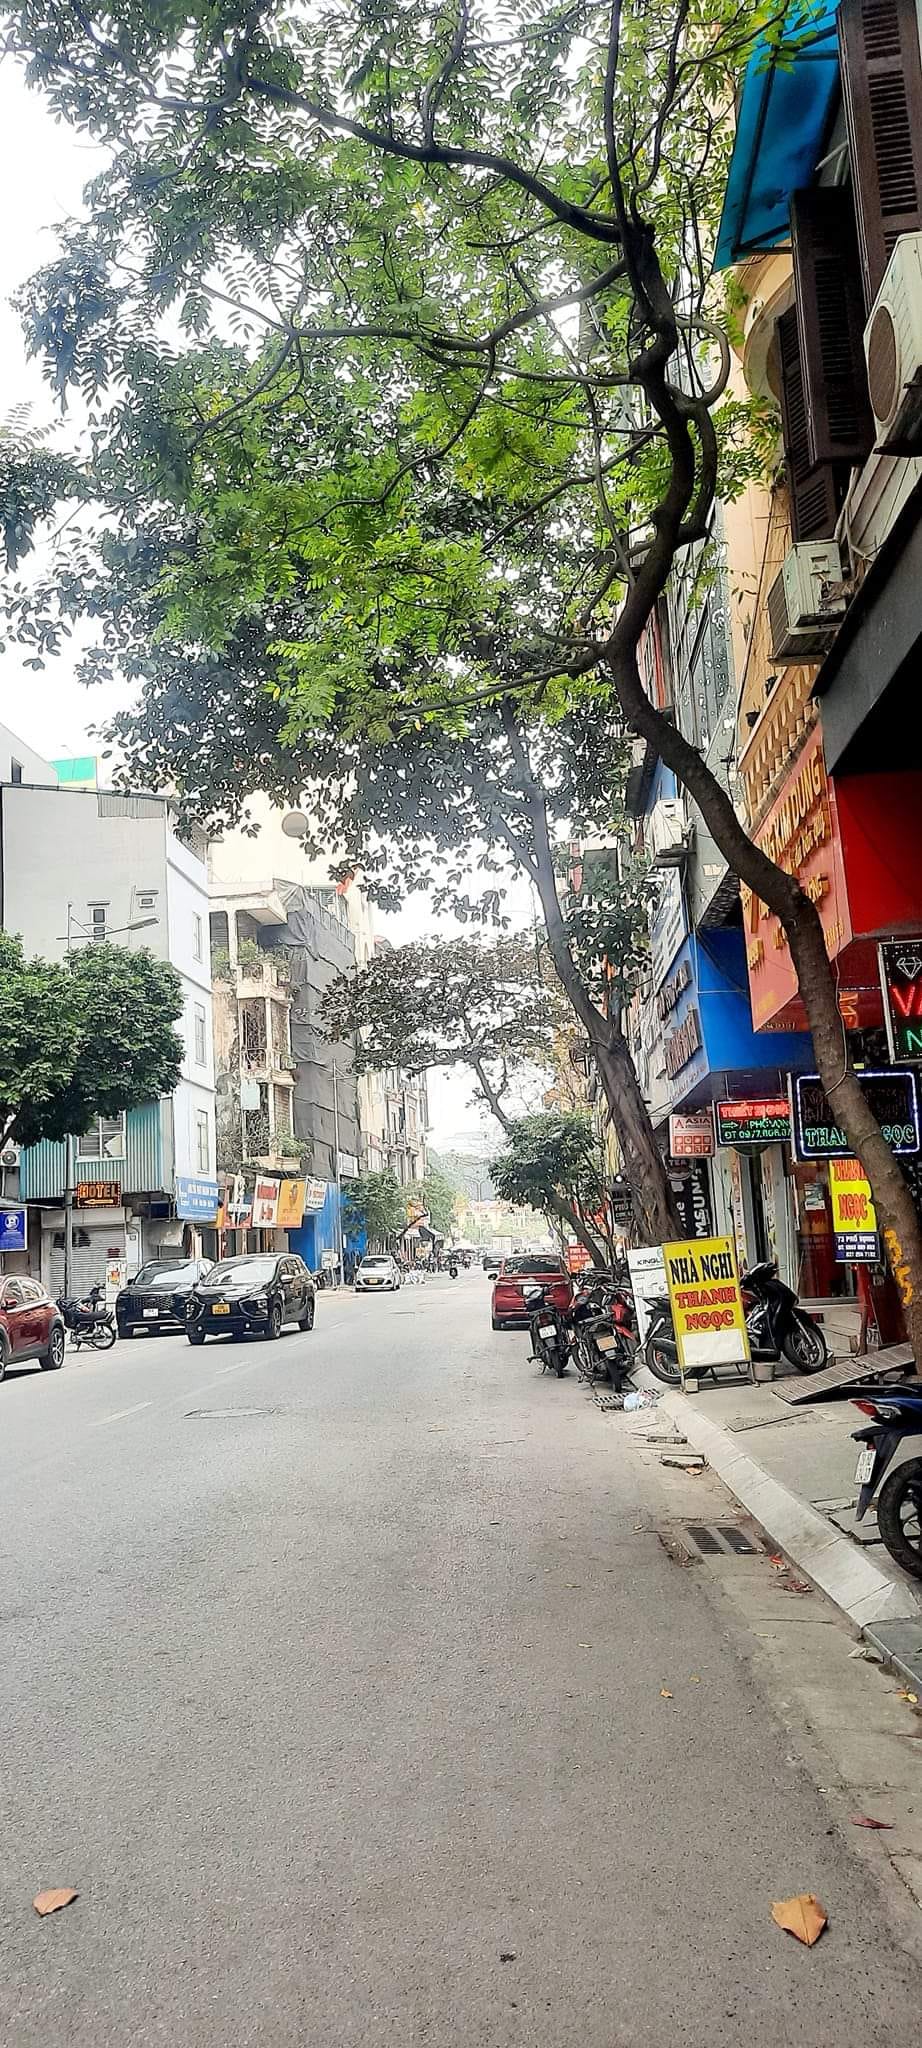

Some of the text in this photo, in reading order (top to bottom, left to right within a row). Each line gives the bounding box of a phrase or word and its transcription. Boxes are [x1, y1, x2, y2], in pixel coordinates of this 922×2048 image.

[805, 1124, 914, 1148] THA GỌC
[79, 1184, 118, 1198] HOTEL
[838, 1193, 868, 1228] NGỌC
[669, 1241, 735, 1285] NHÀ NGHỈ
[675, 1286, 737, 1309] THANH
[684, 1309, 735, 1331] NGỌC
